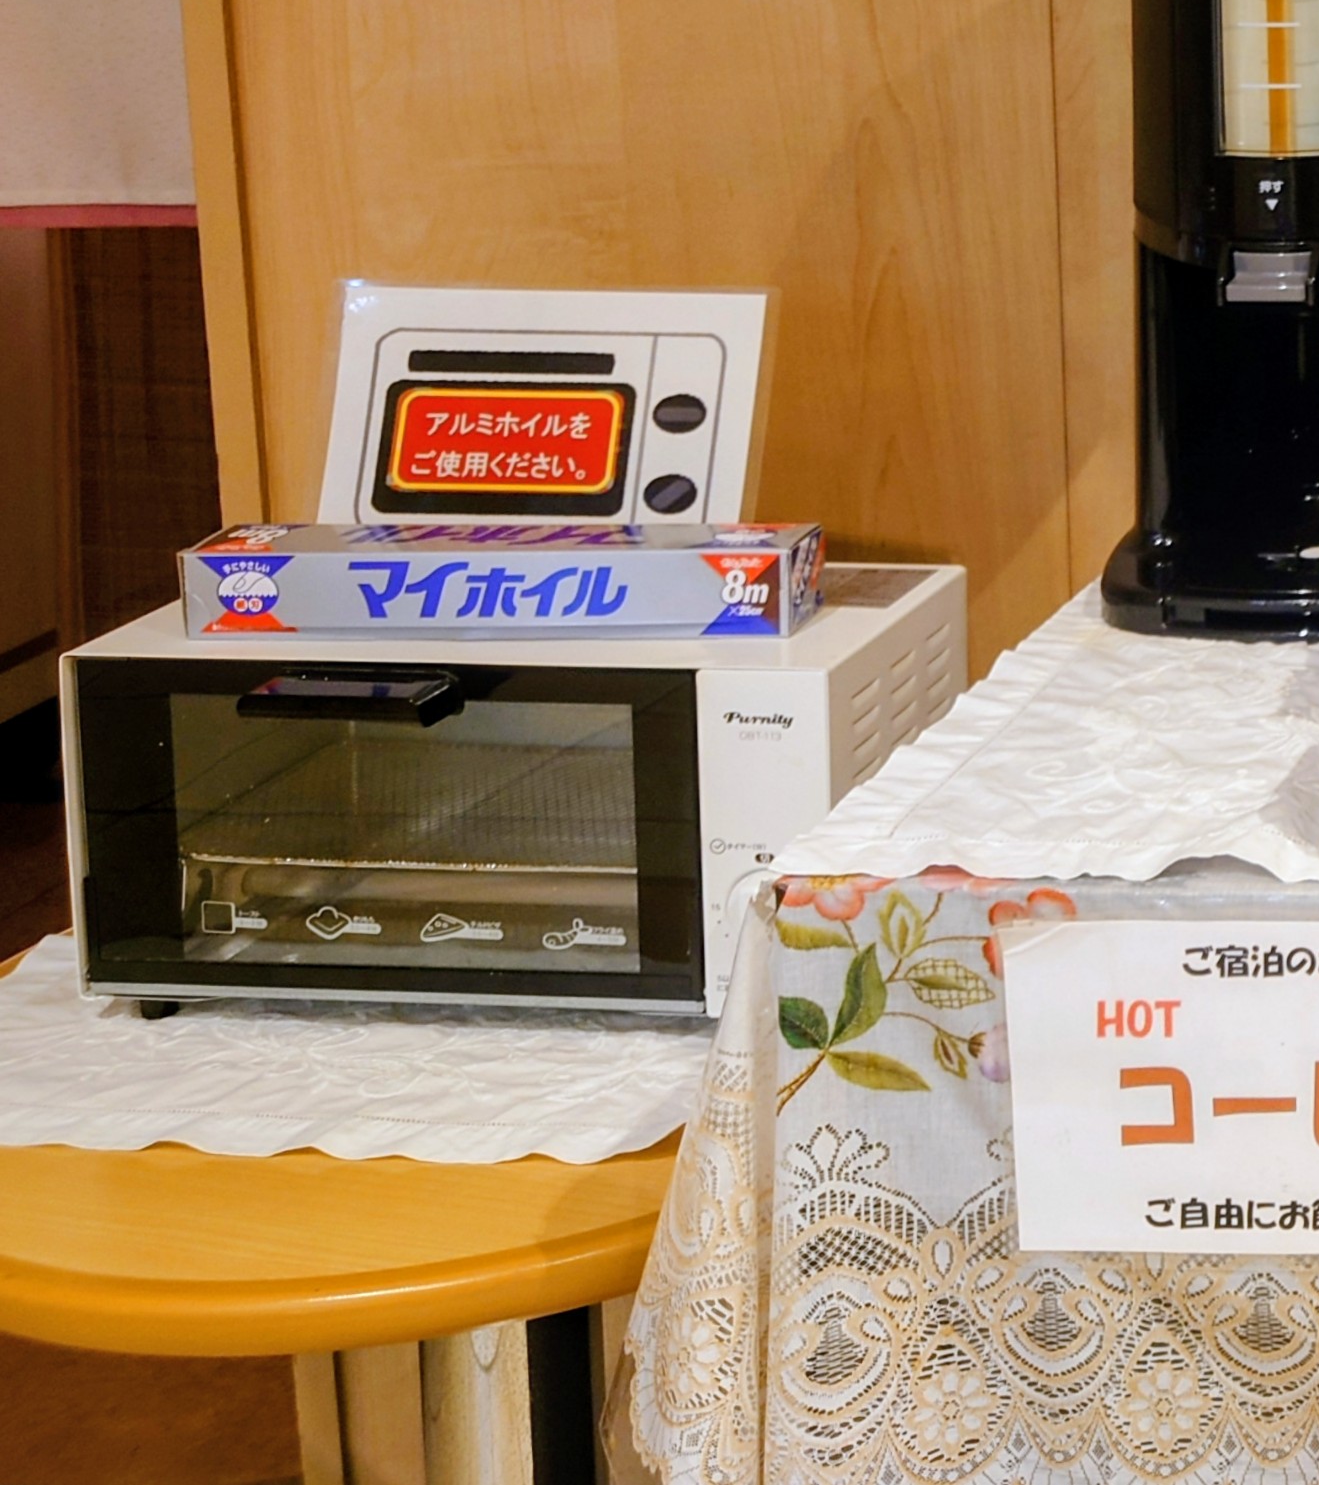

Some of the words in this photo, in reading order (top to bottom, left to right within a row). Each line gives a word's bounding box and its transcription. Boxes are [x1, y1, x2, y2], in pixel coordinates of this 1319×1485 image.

[1258, 180, 1284, 194] 押す
[425, 410, 592, 441] アルミホイルを
[410, 449, 588, 481] ご使用ください。
[348, 562, 628, 618] マイホイル
[721, 569, 770, 605] 8m
[723, 711, 793, 729] Purnity
[1096, 999, 1181, 1038] HOT
